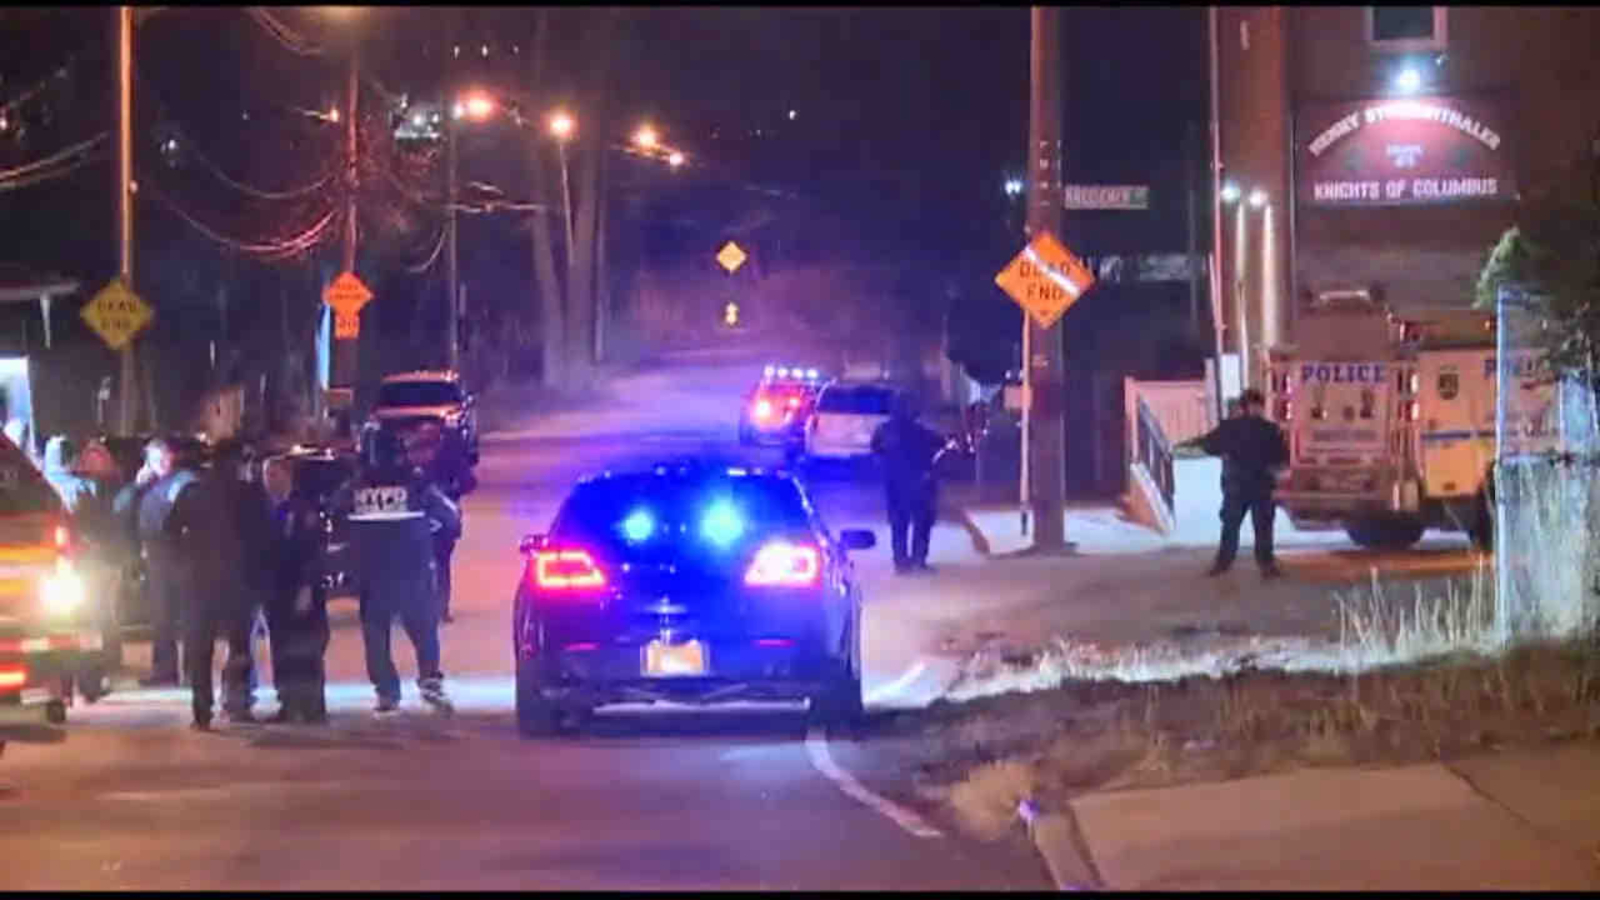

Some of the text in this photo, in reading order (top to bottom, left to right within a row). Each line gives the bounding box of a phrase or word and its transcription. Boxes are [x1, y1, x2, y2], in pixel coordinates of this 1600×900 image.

[1314, 178, 1498, 200] KNIGHTS OF COLUMBUS
[1027, 282, 1062, 301] END
[1301, 363, 1385, 383] POLICE
